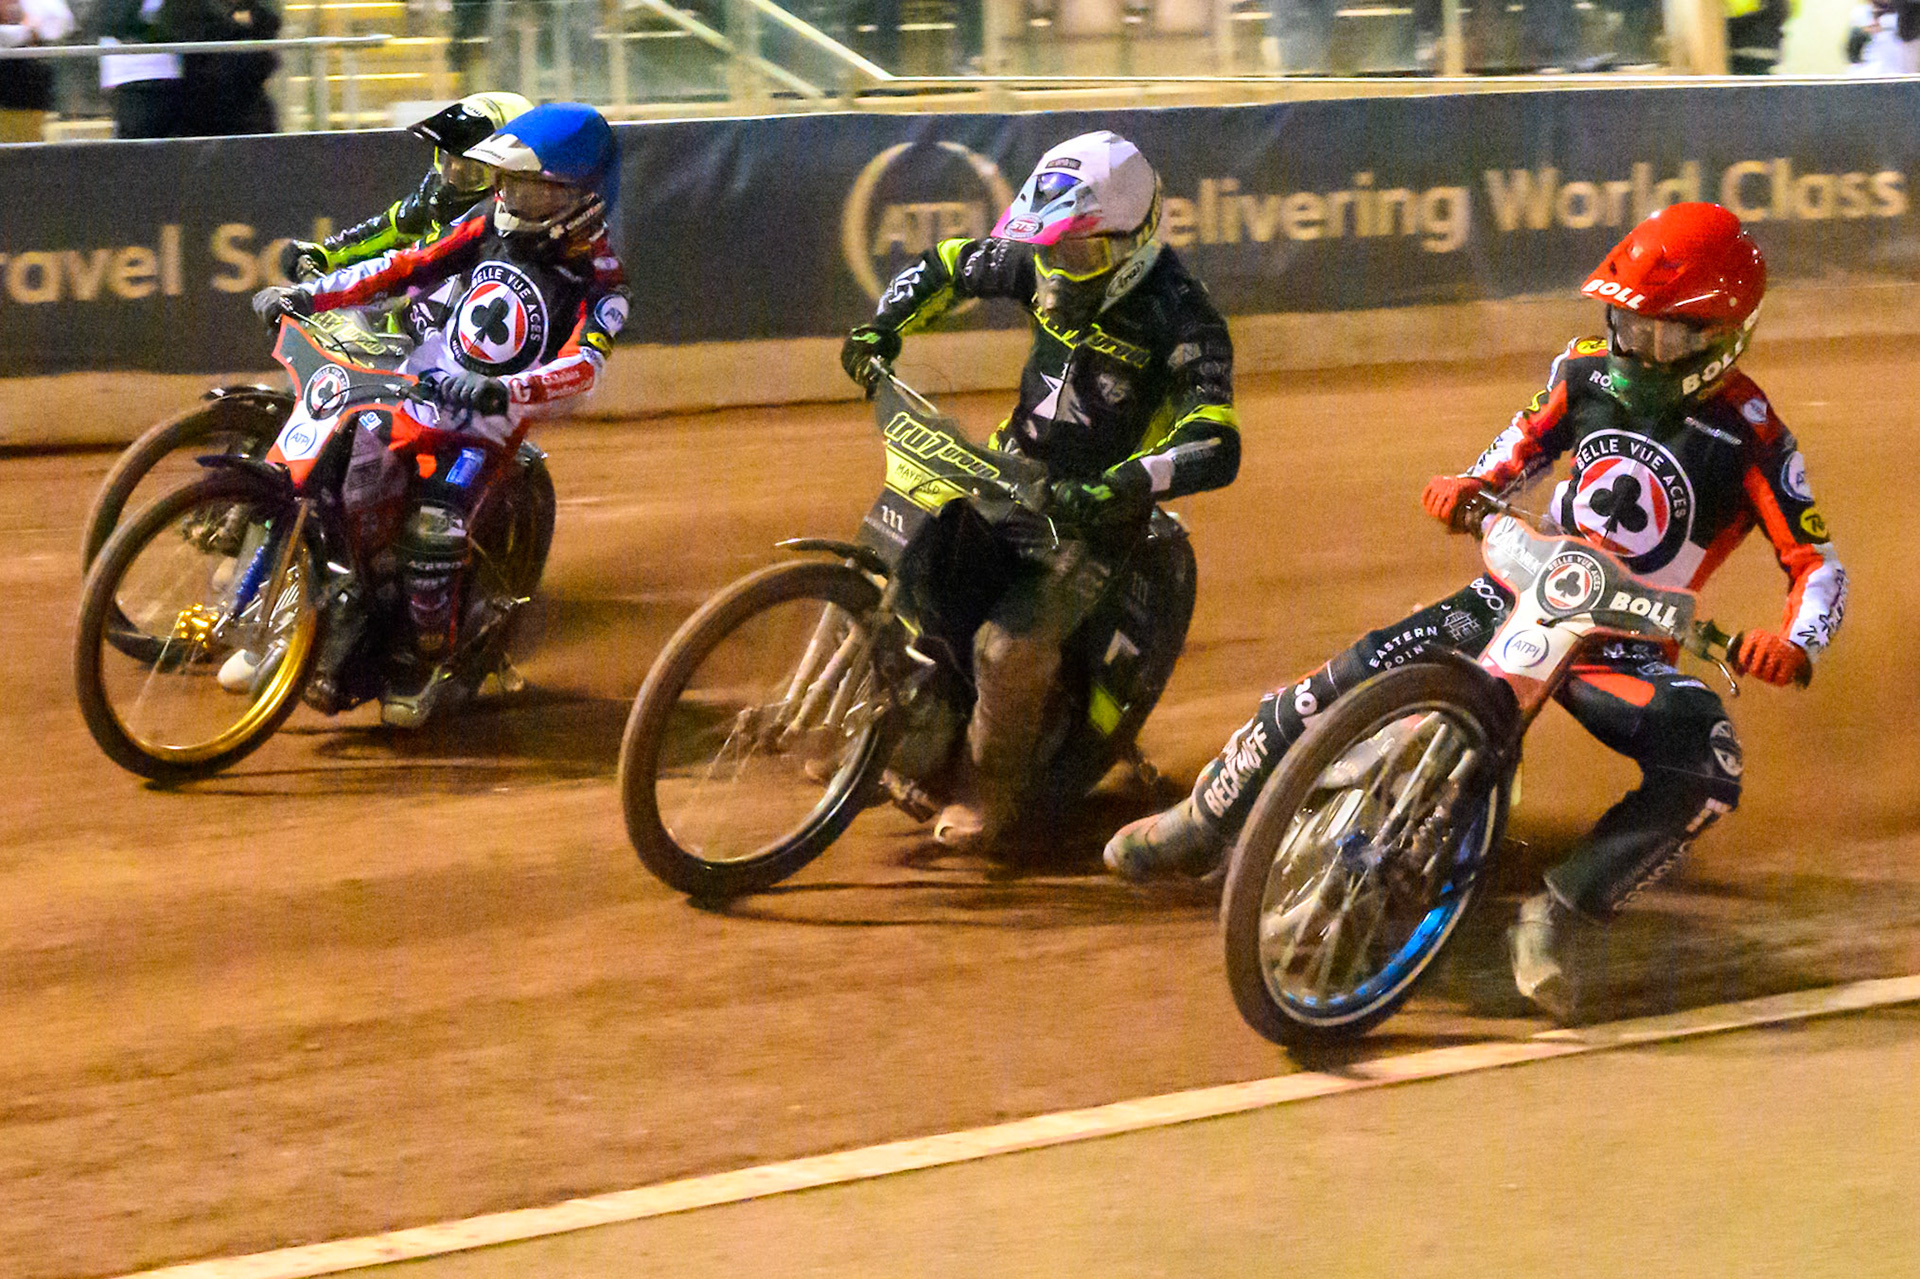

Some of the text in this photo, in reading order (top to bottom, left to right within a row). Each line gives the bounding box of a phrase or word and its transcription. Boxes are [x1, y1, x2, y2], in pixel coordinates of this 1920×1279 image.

[1157, 157, 1908, 253] elivering World Class
[1010, 218, 1036, 233] STS
[0, 223, 182, 304] avel
[506, 273, 532, 299] VUE
[526, 303, 543, 341] ACES
[1582, 279, 1646, 310] BOLL
[1576, 438, 1687, 519] BELLE VUE ACES
[1548, 555, 1574, 571] BELLE
[1576, 556, 1594, 570] VUE
[1591, 569, 1601, 592] ACES
[1609, 591, 1678, 628] BOLL
[1369, 626, 1439, 669] EASTERN
[1513, 639, 1540, 658] ATPI
